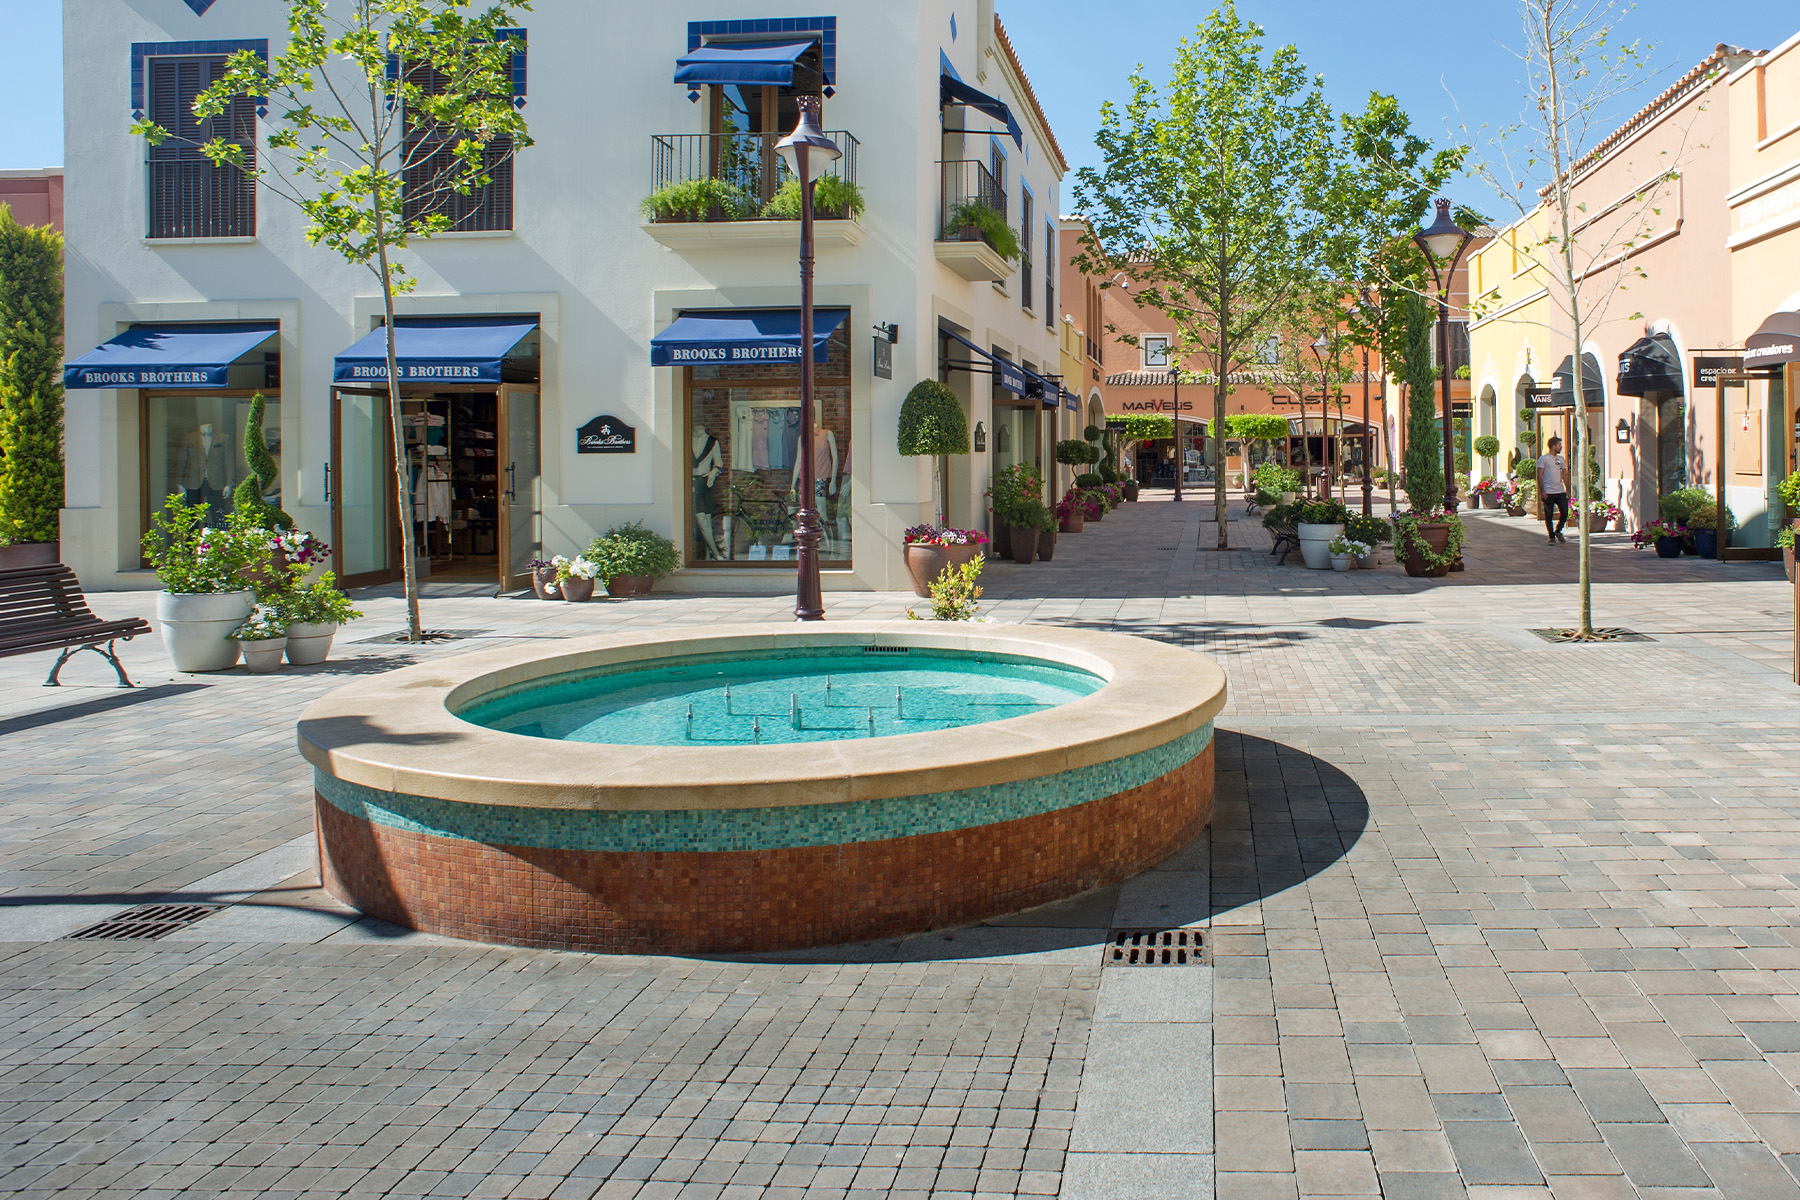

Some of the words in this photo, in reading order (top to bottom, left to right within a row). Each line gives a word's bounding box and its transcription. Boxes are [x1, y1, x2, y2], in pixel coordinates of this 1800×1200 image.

[673, 348, 727, 360] BROOKS
[353, 366, 404, 377] BROOS
[409, 366, 479, 377] BROTHERS
[1700, 366, 1727, 376] espacio
[85, 372, 135, 383] BROOKS
[140, 371, 208, 383] BROTHERS
